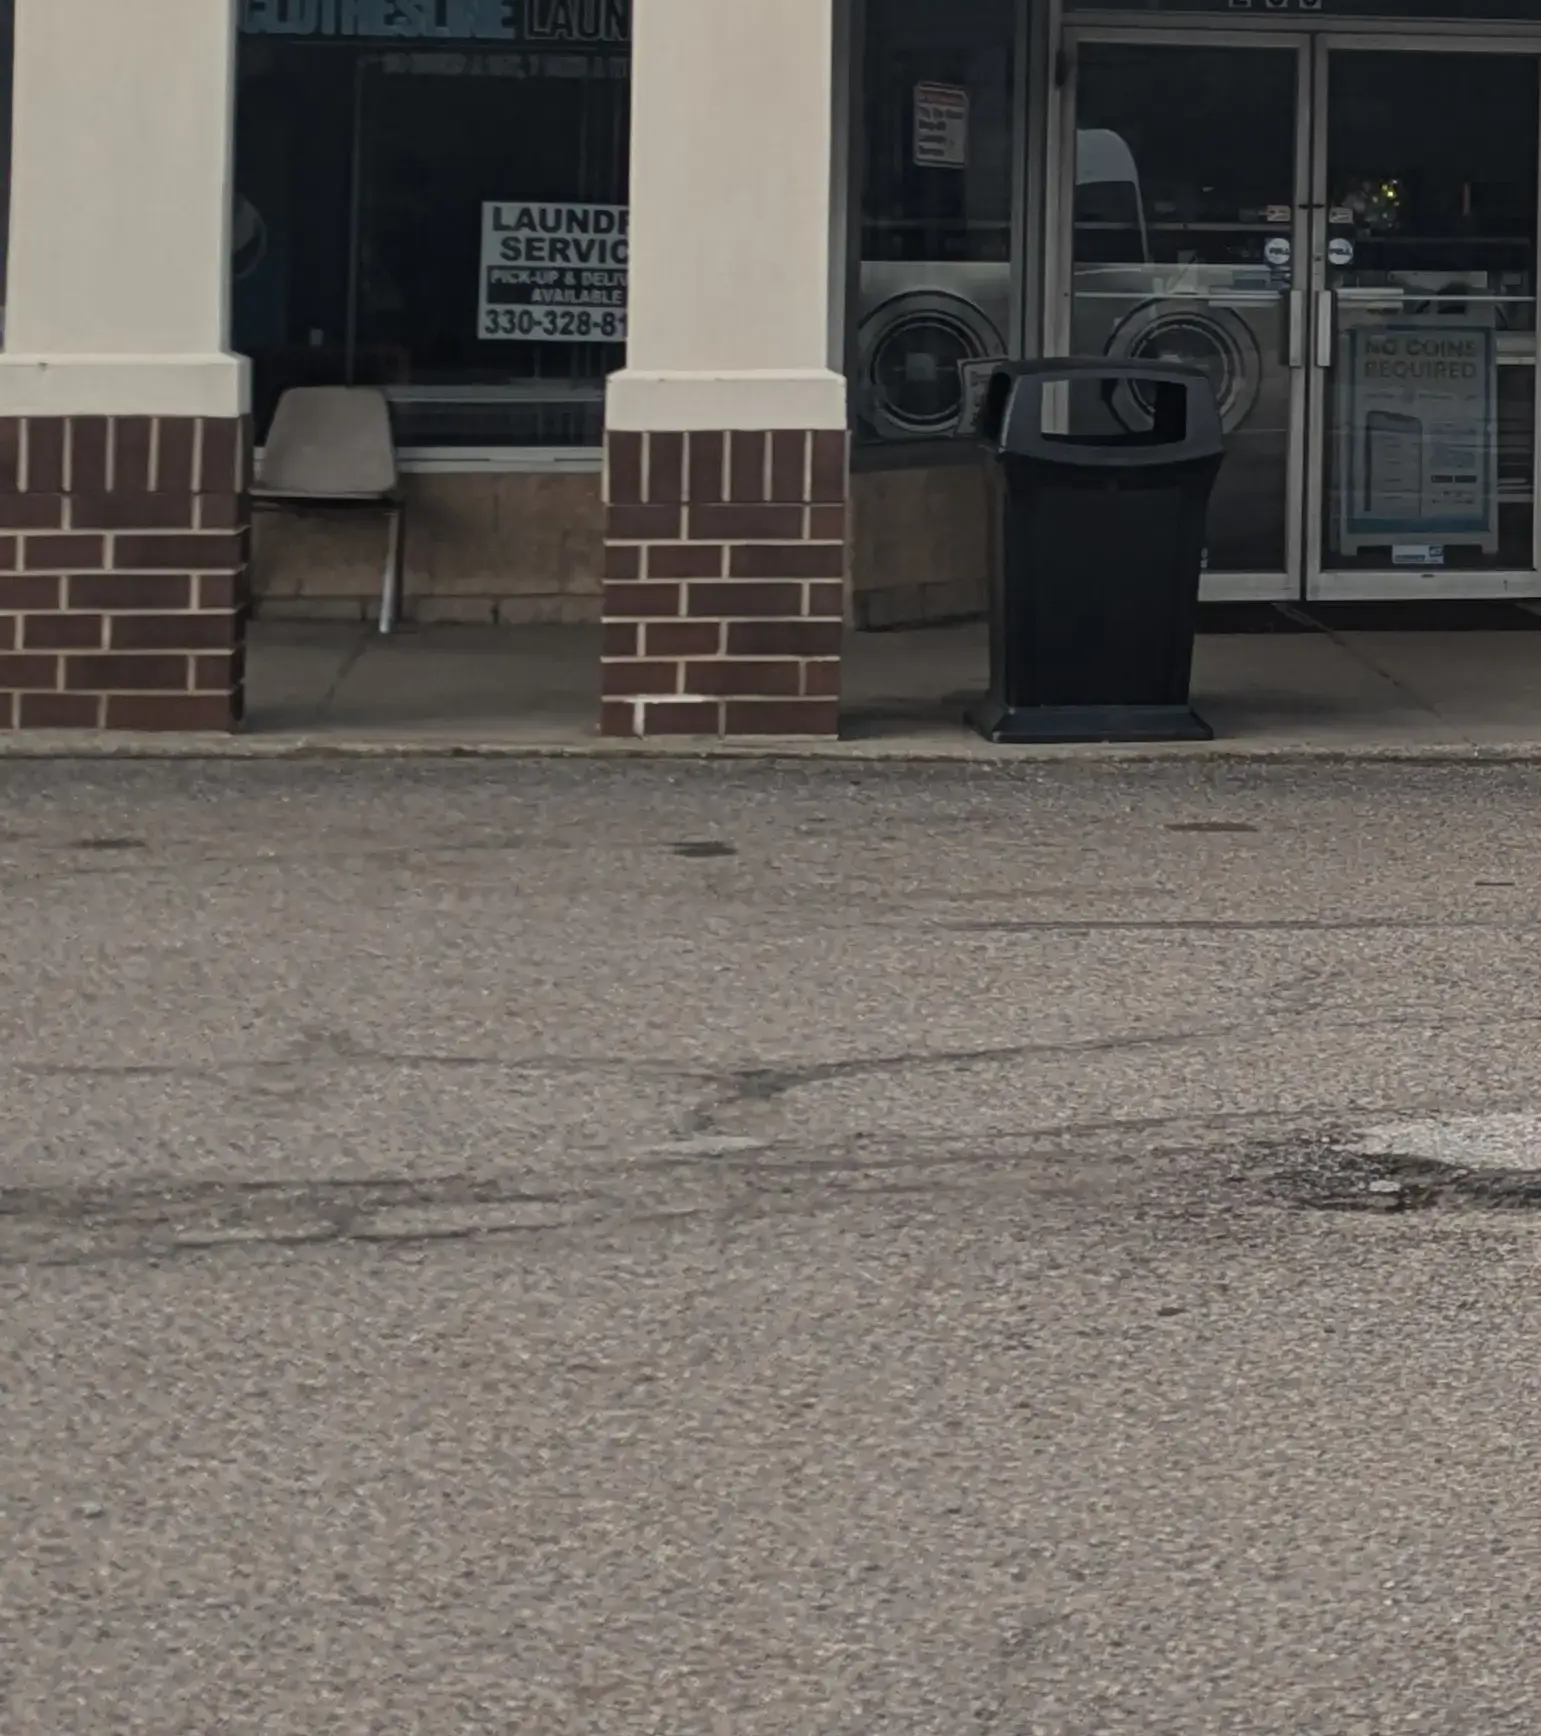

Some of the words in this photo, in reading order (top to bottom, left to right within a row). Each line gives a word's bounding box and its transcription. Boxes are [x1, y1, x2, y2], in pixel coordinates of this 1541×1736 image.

[490, 270, 560, 285] PICK-UP
[564, 271, 577, 286] &
[531, 288, 623, 304] AVAILABLE
[1364, 338, 1398, 356] NO
[1406, 338, 1478, 357] COINS
[1364, 360, 1476, 380] REQUIRED
